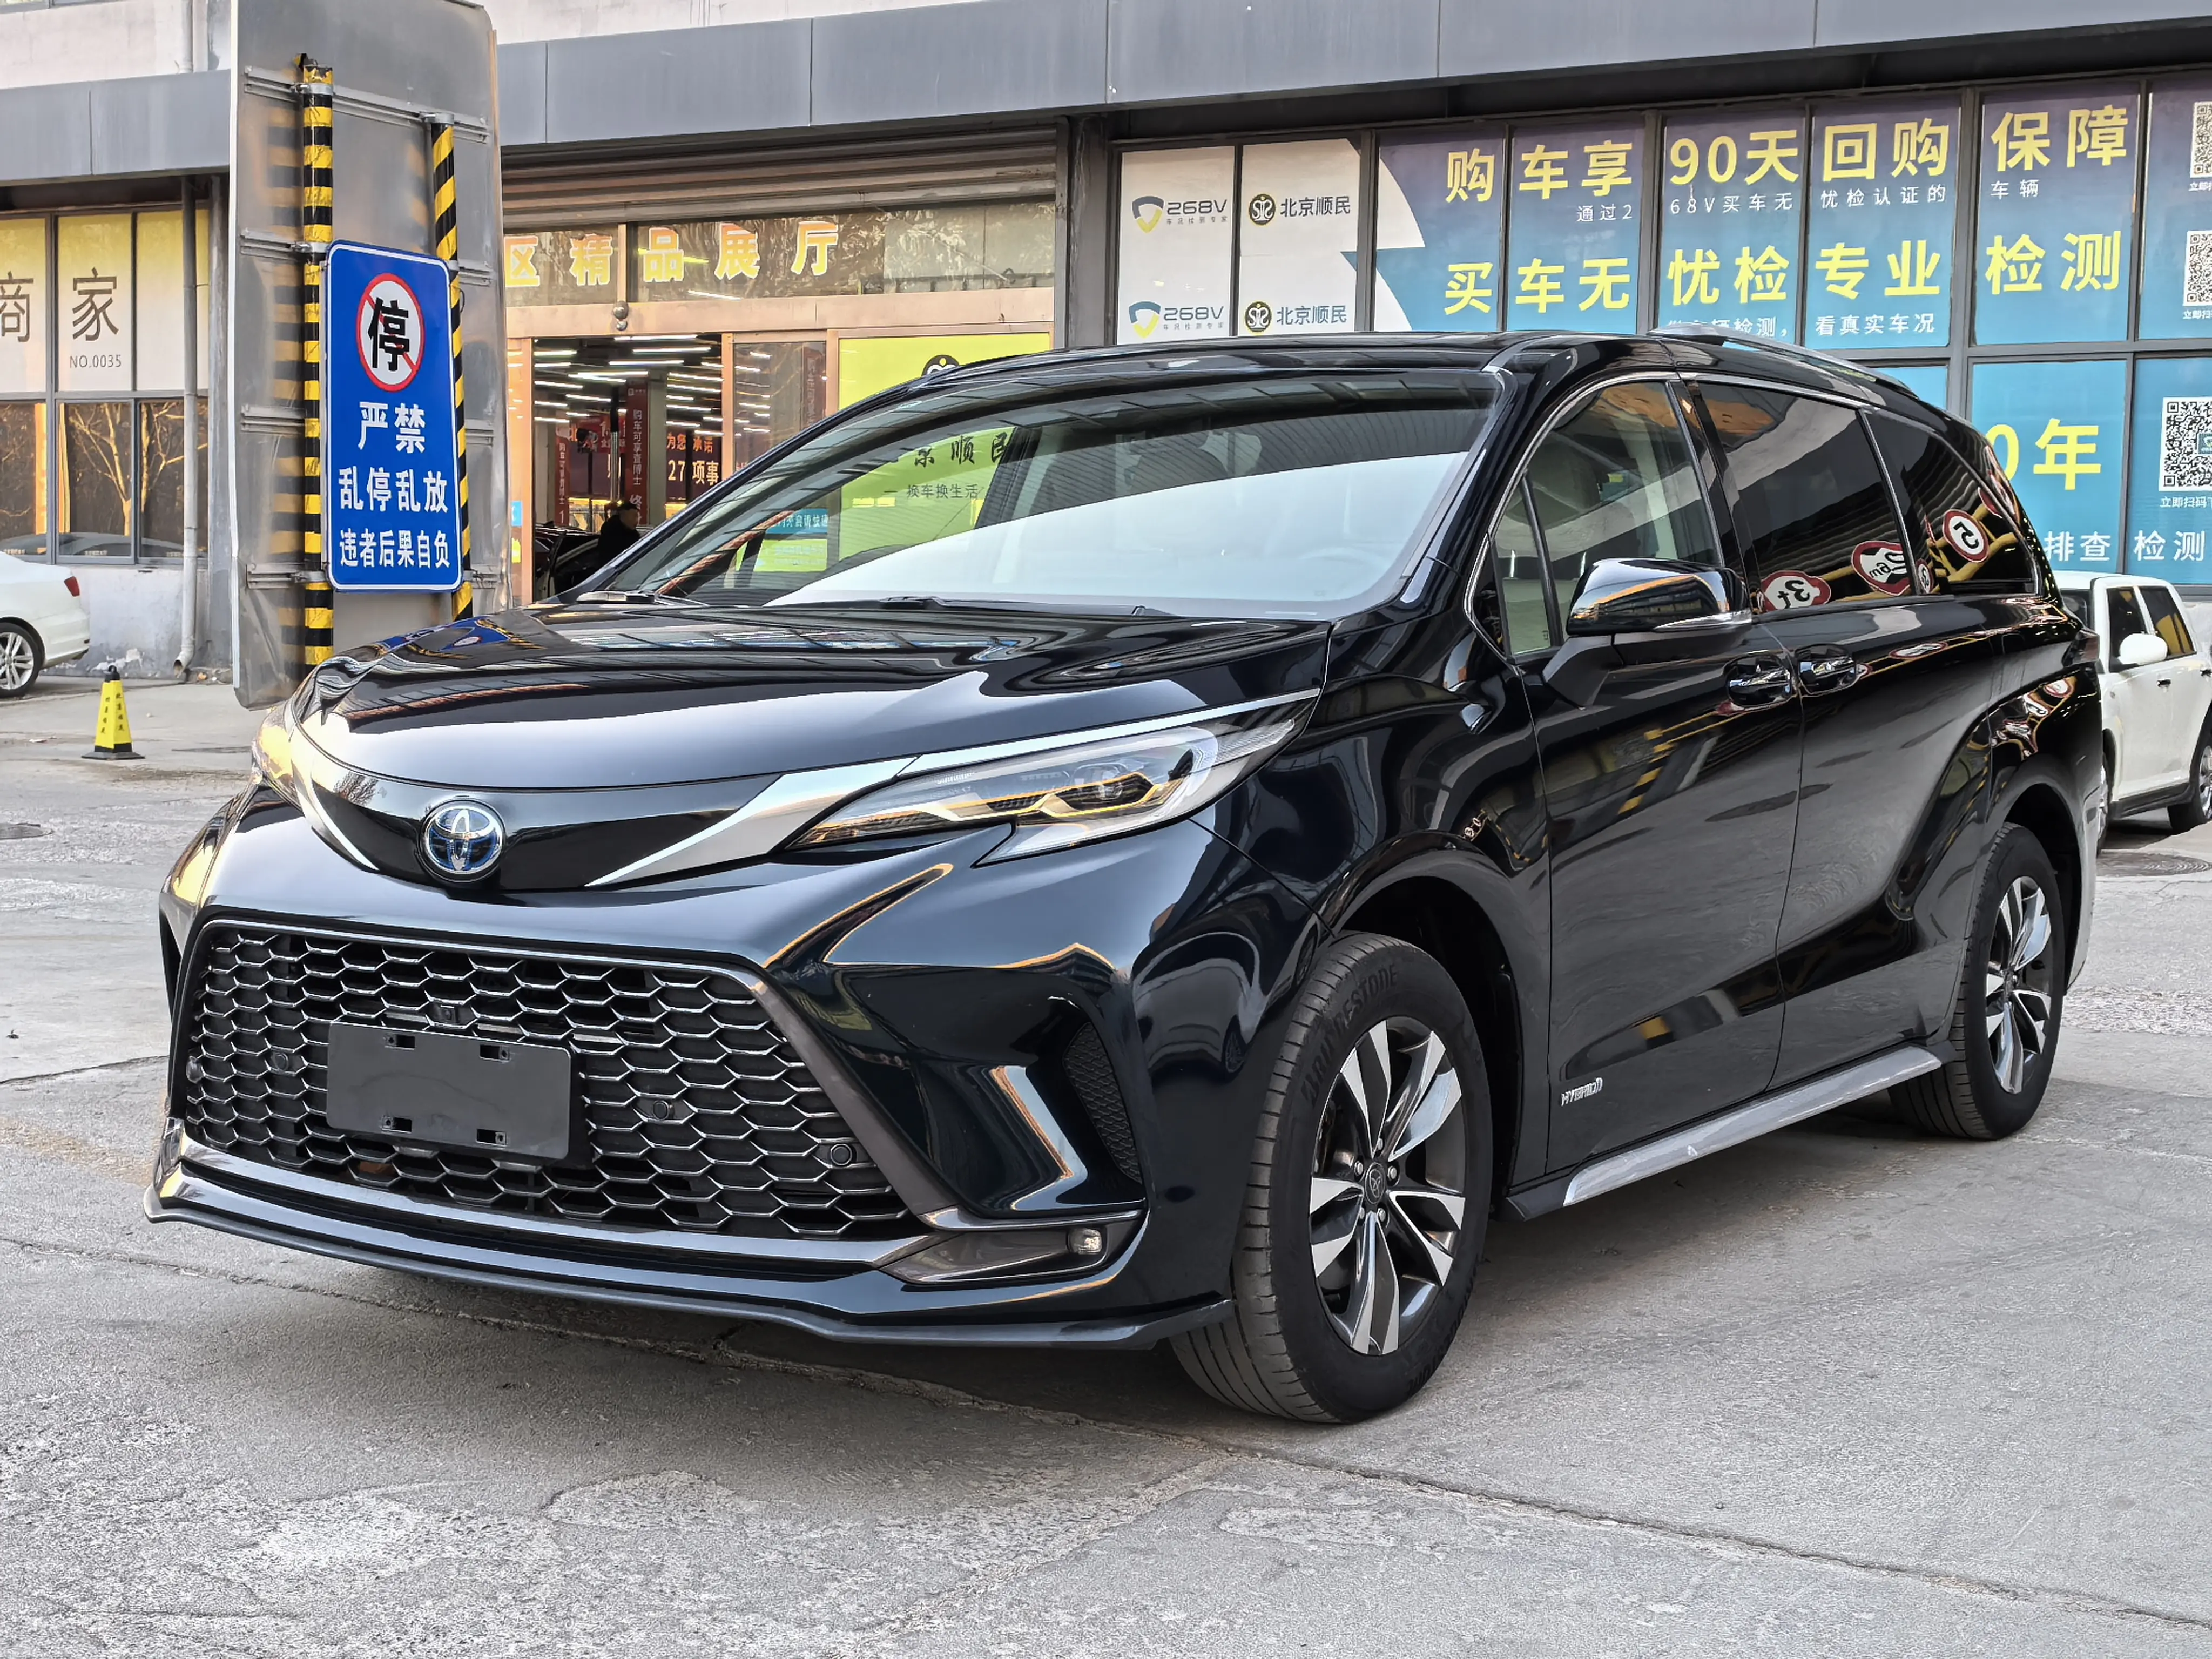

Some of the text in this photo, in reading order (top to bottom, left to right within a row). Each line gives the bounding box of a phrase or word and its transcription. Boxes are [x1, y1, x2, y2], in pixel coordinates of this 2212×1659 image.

[1167, 199, 1227, 215] 268V
[1280, 195, 1351, 217] 北京顺民
[1164, 306, 1224, 321] 268V
[1276, 305, 1347, 326] 北京顺民
[368, 296, 410, 372] 停
[69, 354, 122, 369] NO.0035
[358, 401, 427, 454] 严禁
[667, 460, 719, 486] 27项事
[338, 466, 449, 514] 乱停乱放
[906, 484, 979, 500] 换车换生活
[339, 527, 451, 570] 违者后果自负
